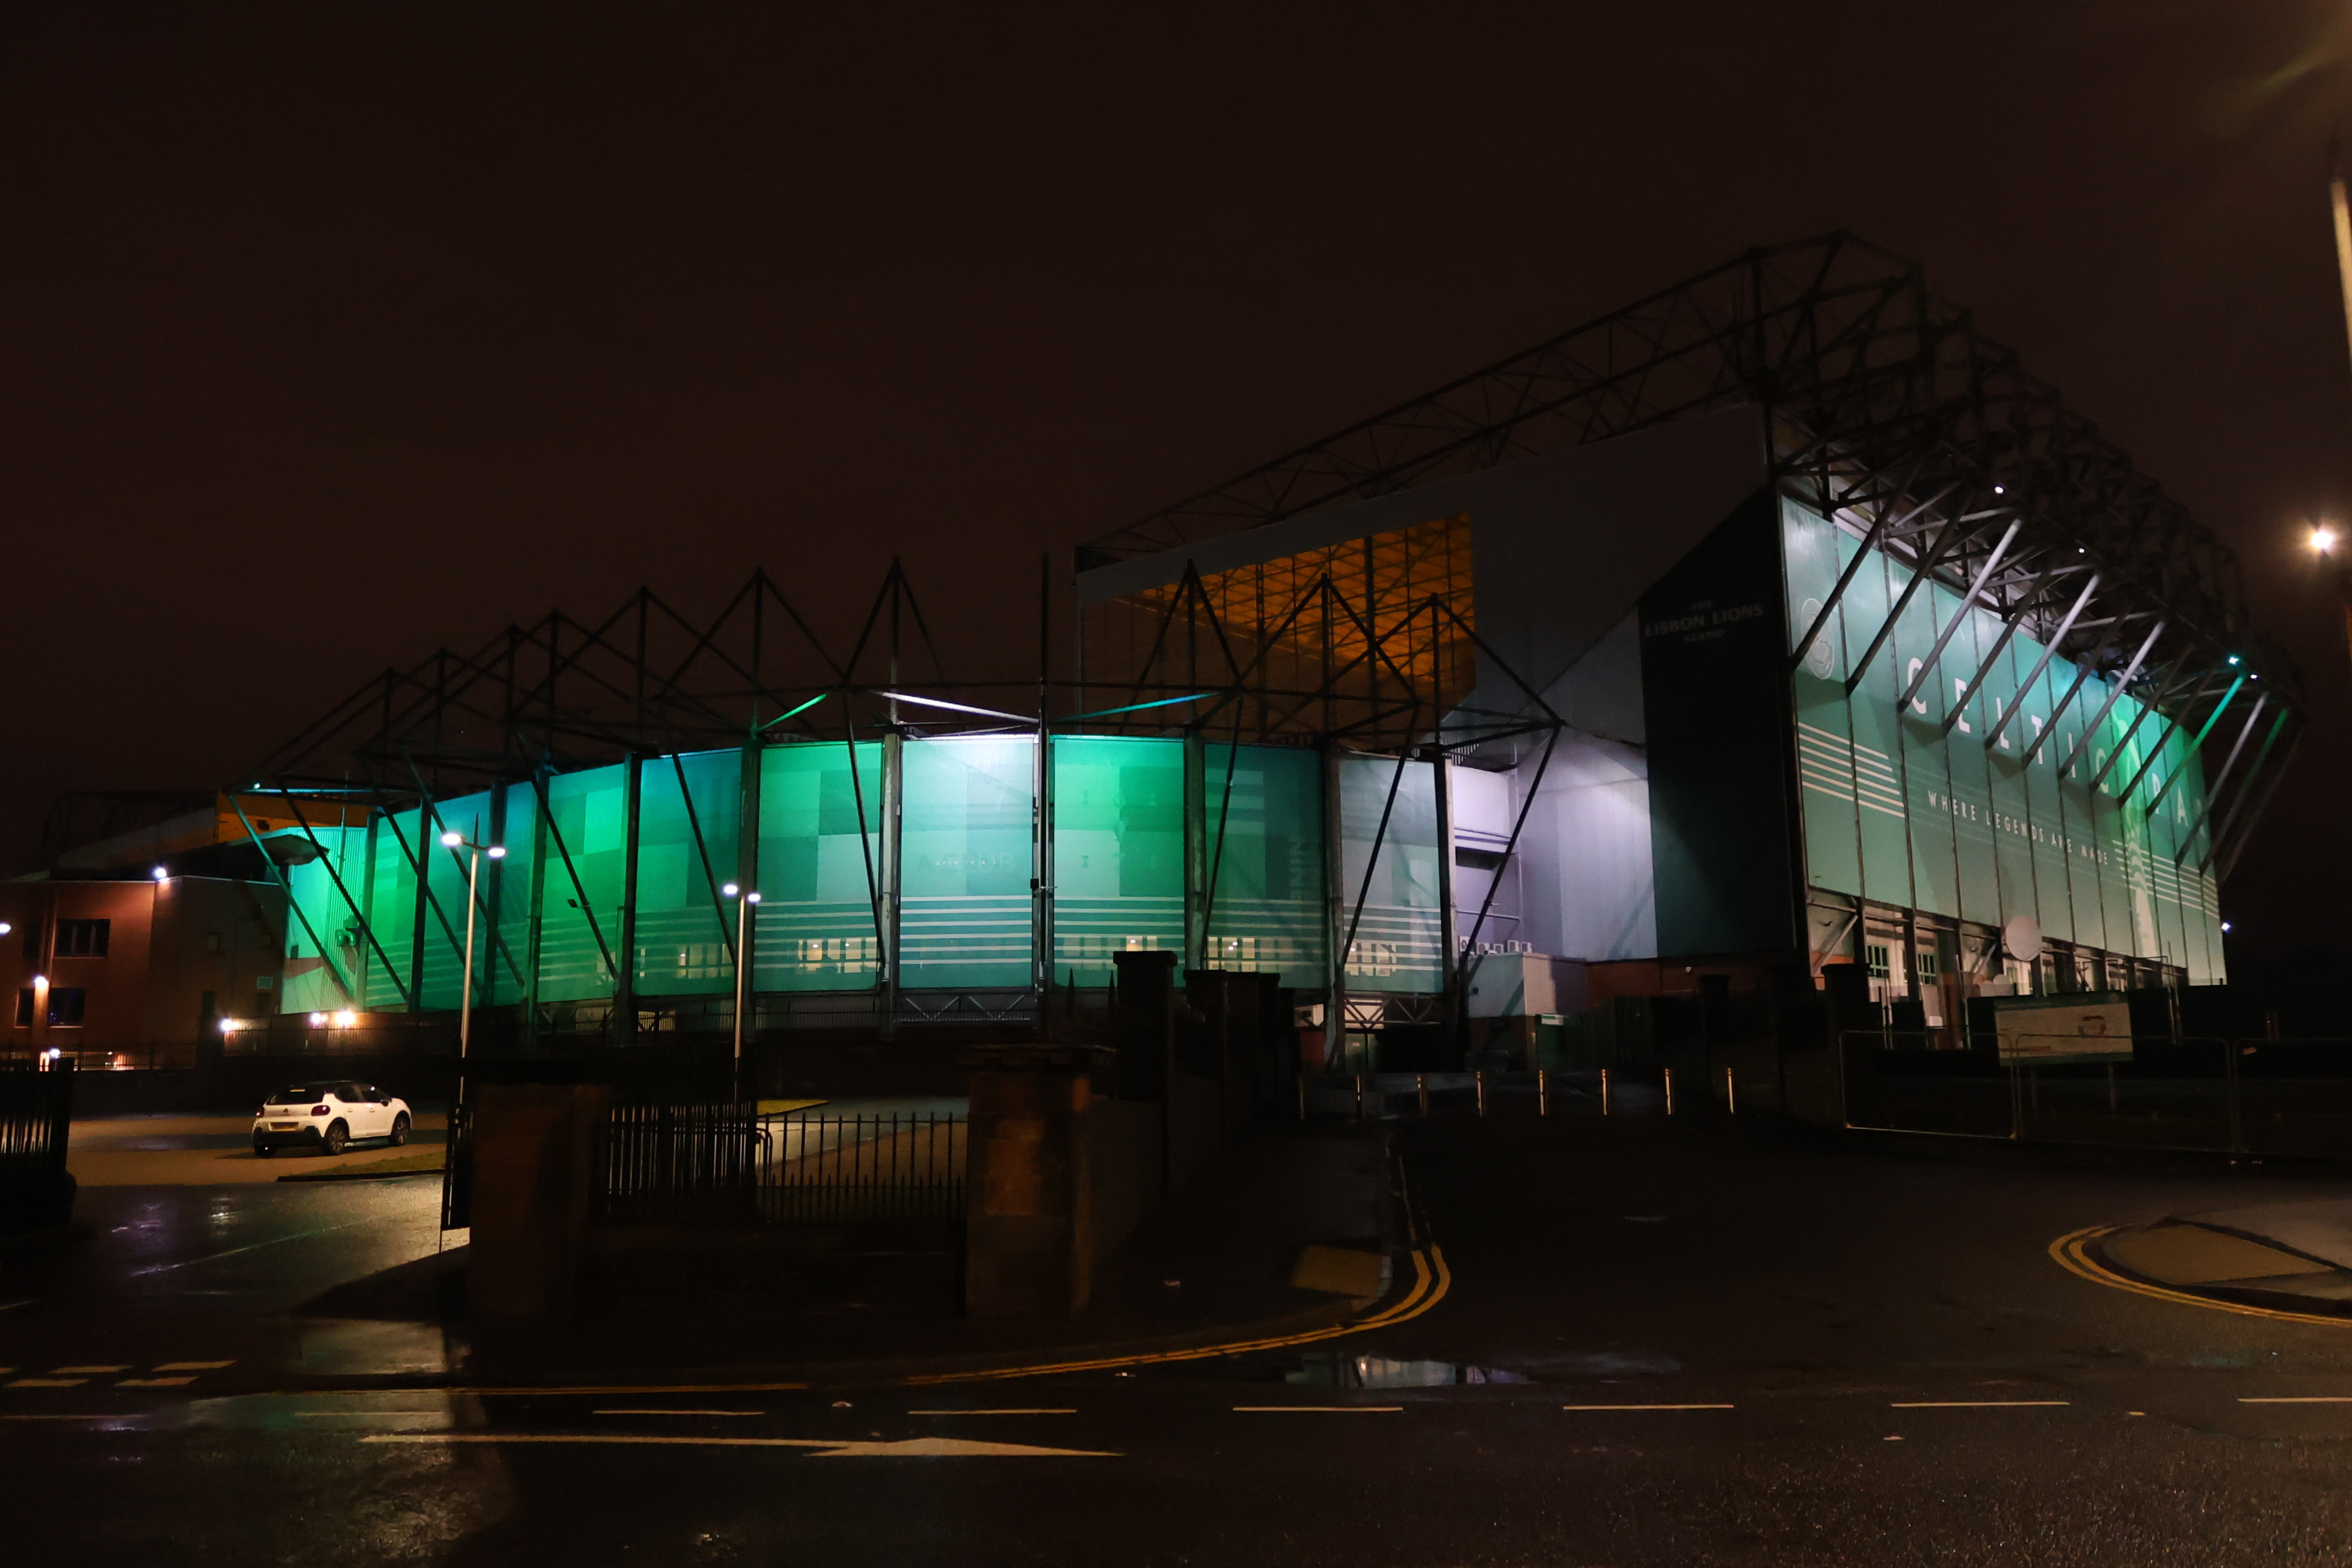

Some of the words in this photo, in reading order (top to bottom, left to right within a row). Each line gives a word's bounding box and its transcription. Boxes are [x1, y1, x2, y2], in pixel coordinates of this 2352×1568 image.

[1645, 615, 1704, 636] LISBON
[1713, 604, 1763, 624] LIONS
[1684, 629, 1724, 642] STAND
[1907, 656, 2110, 793] CELTIC
[1927, 789, 1976, 821] WHERE
[1985, 810, 2044, 843] LEGENDS
[2051, 832, 2073, 853] ARE
[2081, 844, 2108, 866] MADE
